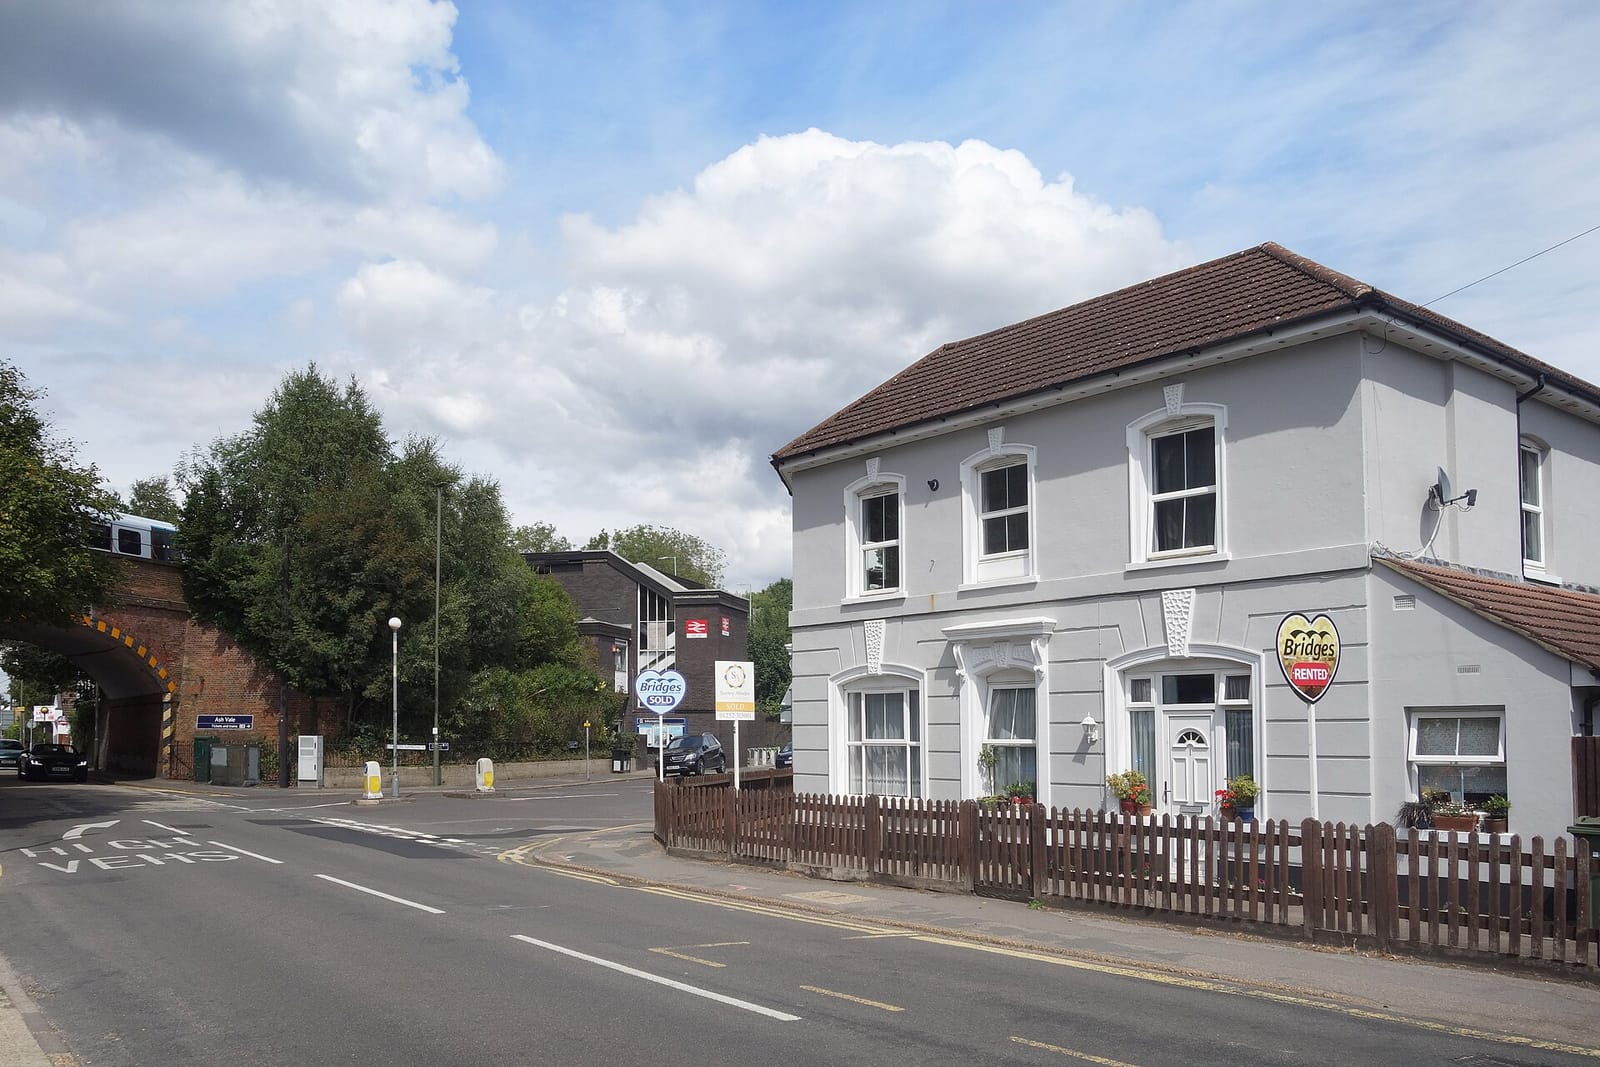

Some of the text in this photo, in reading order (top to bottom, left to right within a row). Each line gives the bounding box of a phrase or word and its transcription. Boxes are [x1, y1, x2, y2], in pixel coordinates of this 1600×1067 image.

[1283, 637, 1335, 661] Bridges
[1294, 668, 1328, 680] RENTED
[640, 681, 682, 694] Bridges
[19, 837, 201, 858] HIGH
